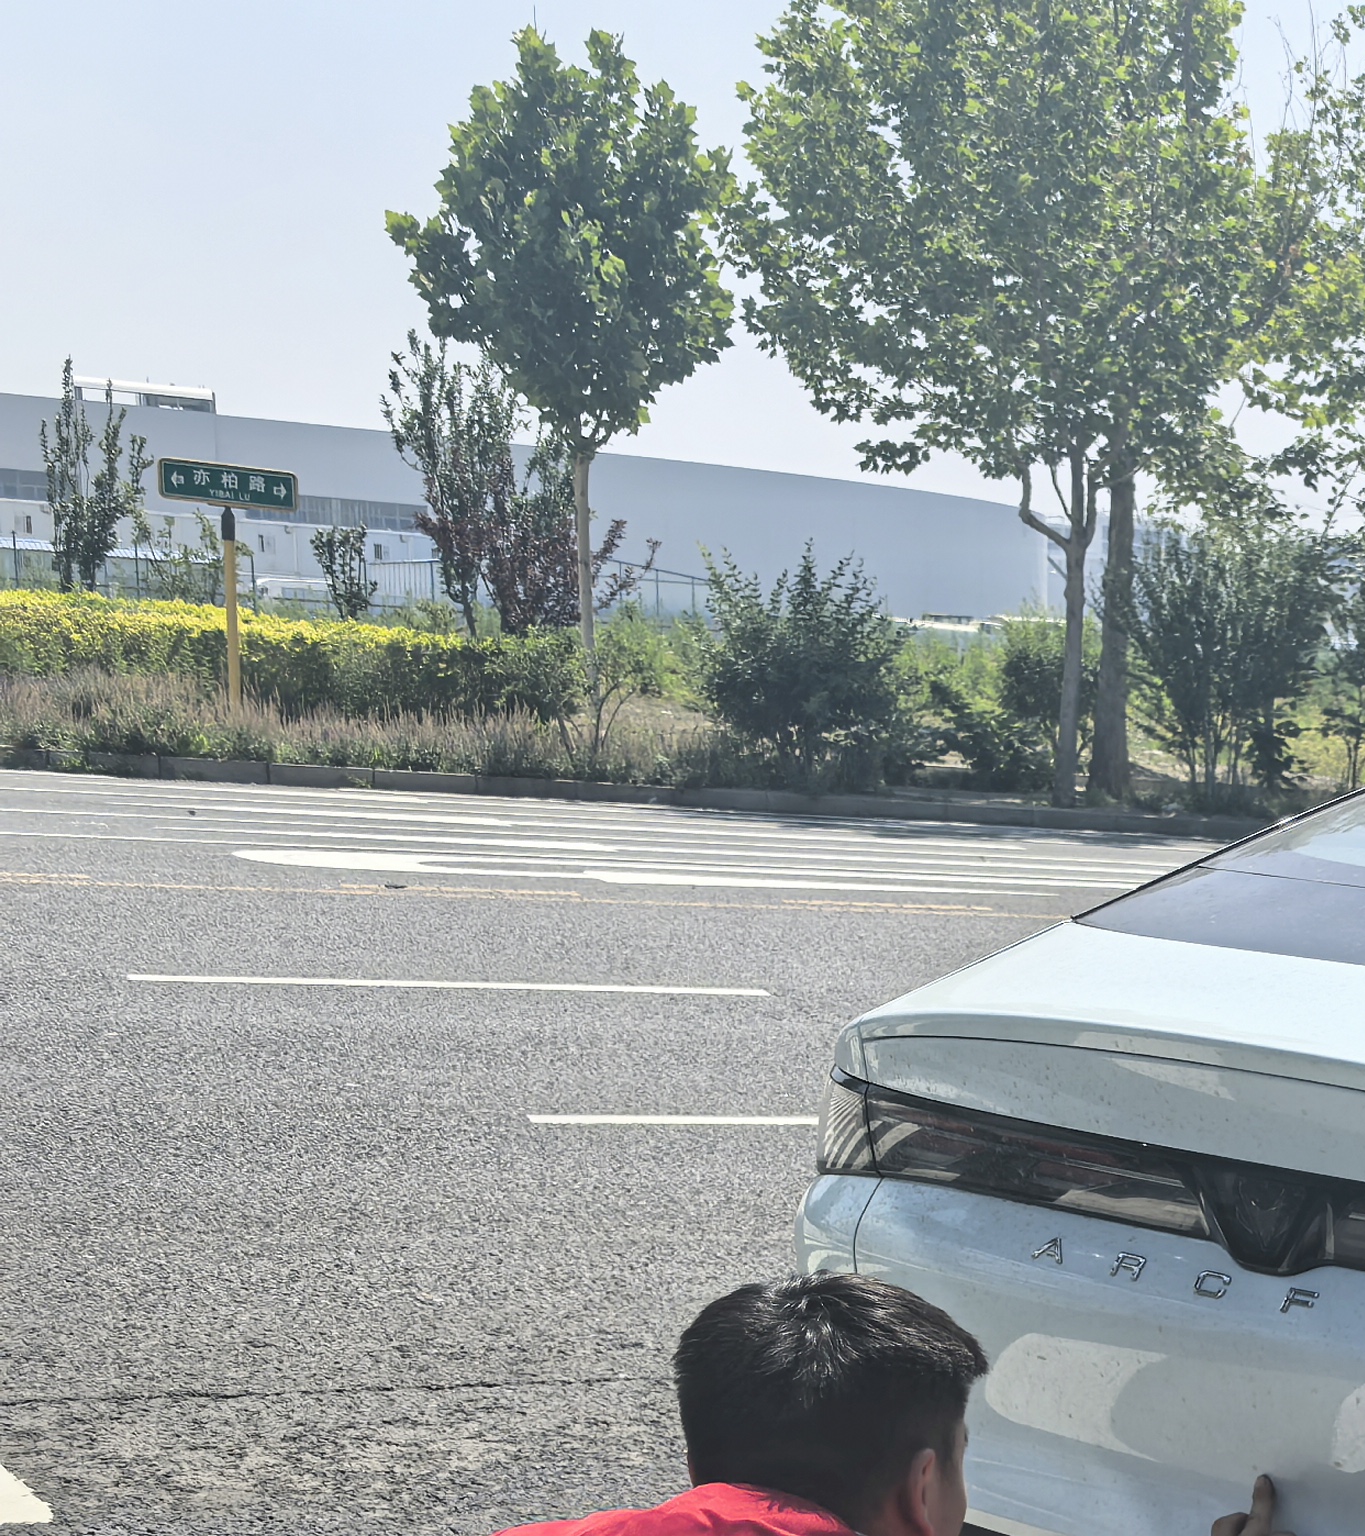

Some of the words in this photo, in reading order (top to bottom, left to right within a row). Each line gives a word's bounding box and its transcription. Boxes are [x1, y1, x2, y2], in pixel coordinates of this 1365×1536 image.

[193, 469, 266, 493] 亦柏路
[209, 488, 235, 500] YIBAI
[238, 491, 251, 501] LU
